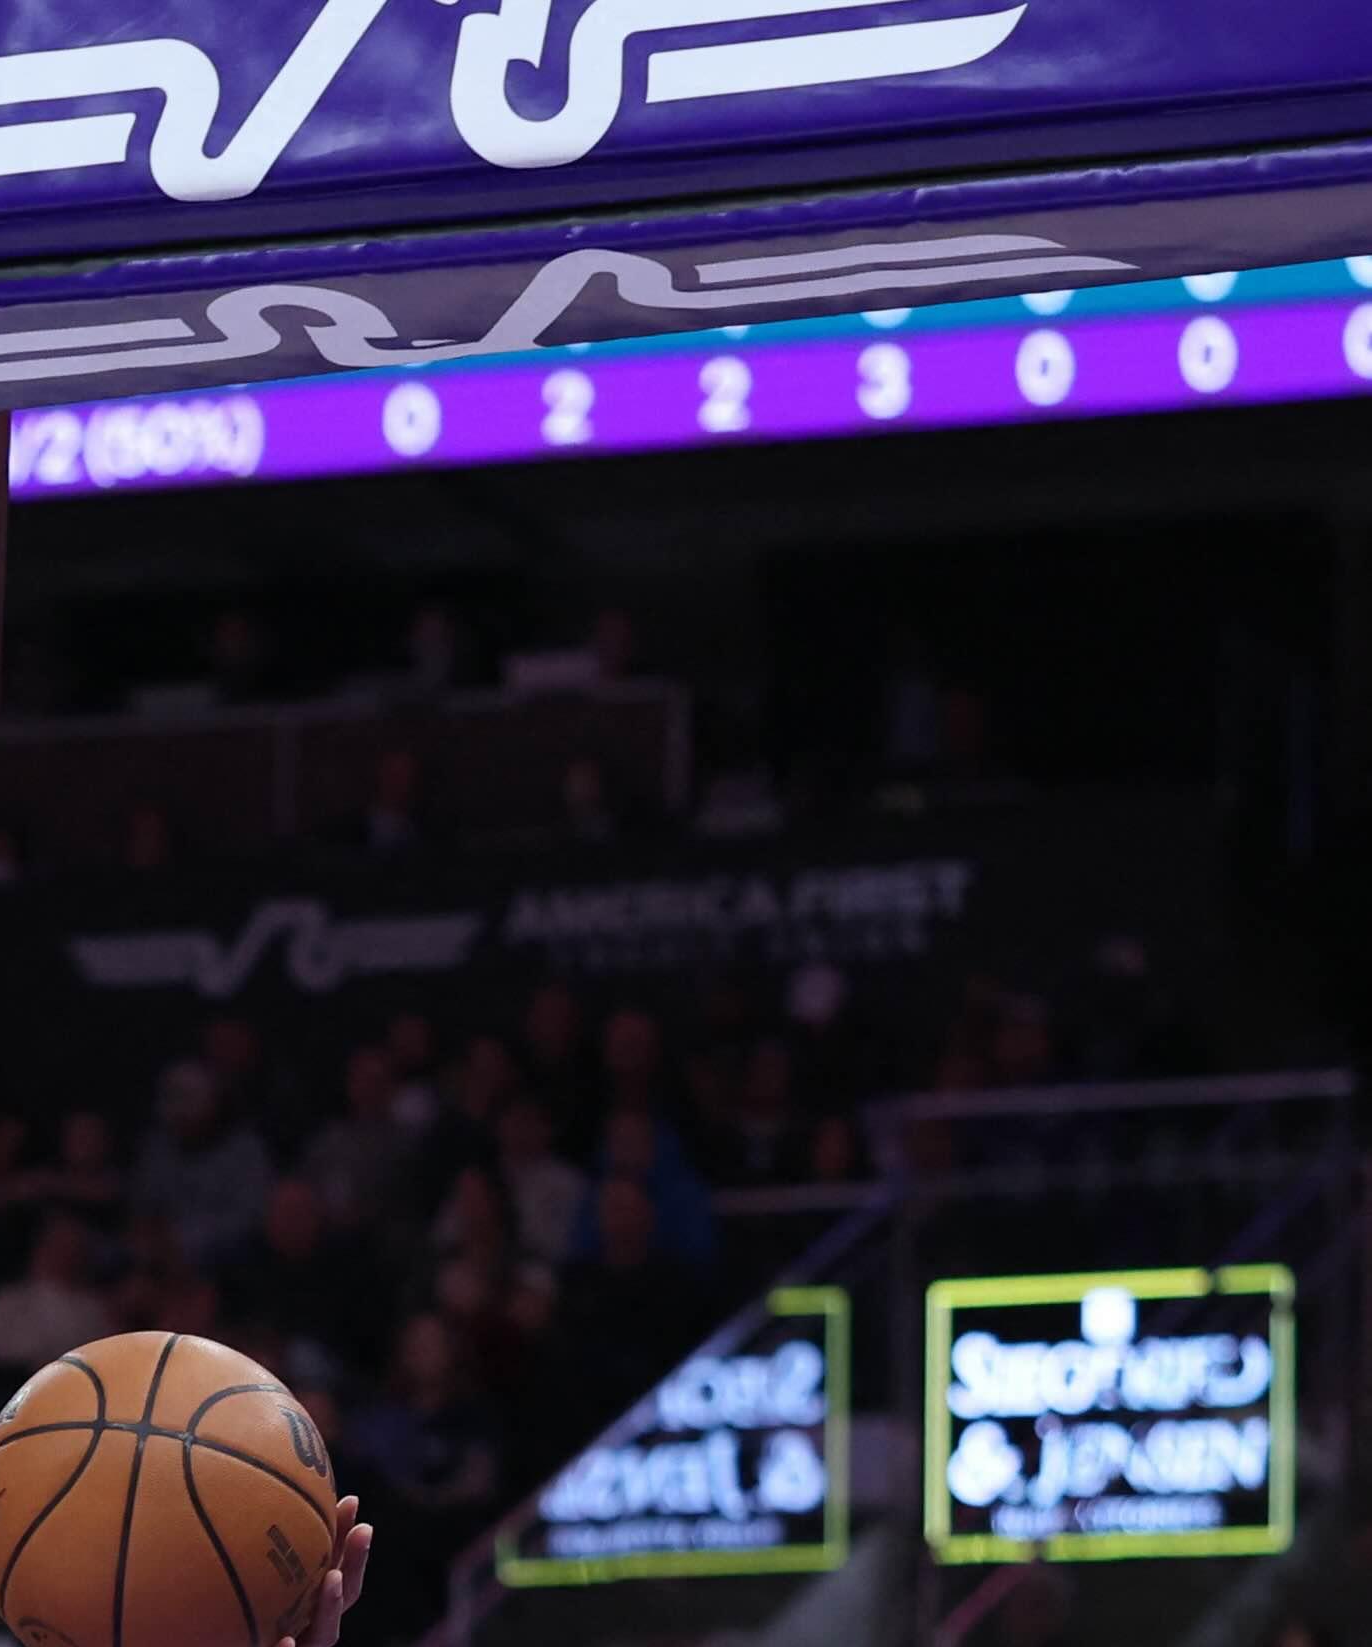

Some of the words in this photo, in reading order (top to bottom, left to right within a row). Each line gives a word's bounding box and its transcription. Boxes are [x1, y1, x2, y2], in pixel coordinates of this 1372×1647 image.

[383, 382, 441, 457] 0
[697, 355, 753, 432] 2
[856, 341, 912, 420] 3
[1014, 328, 1075, 407] 0
[1177, 315, 1239, 394] 0
